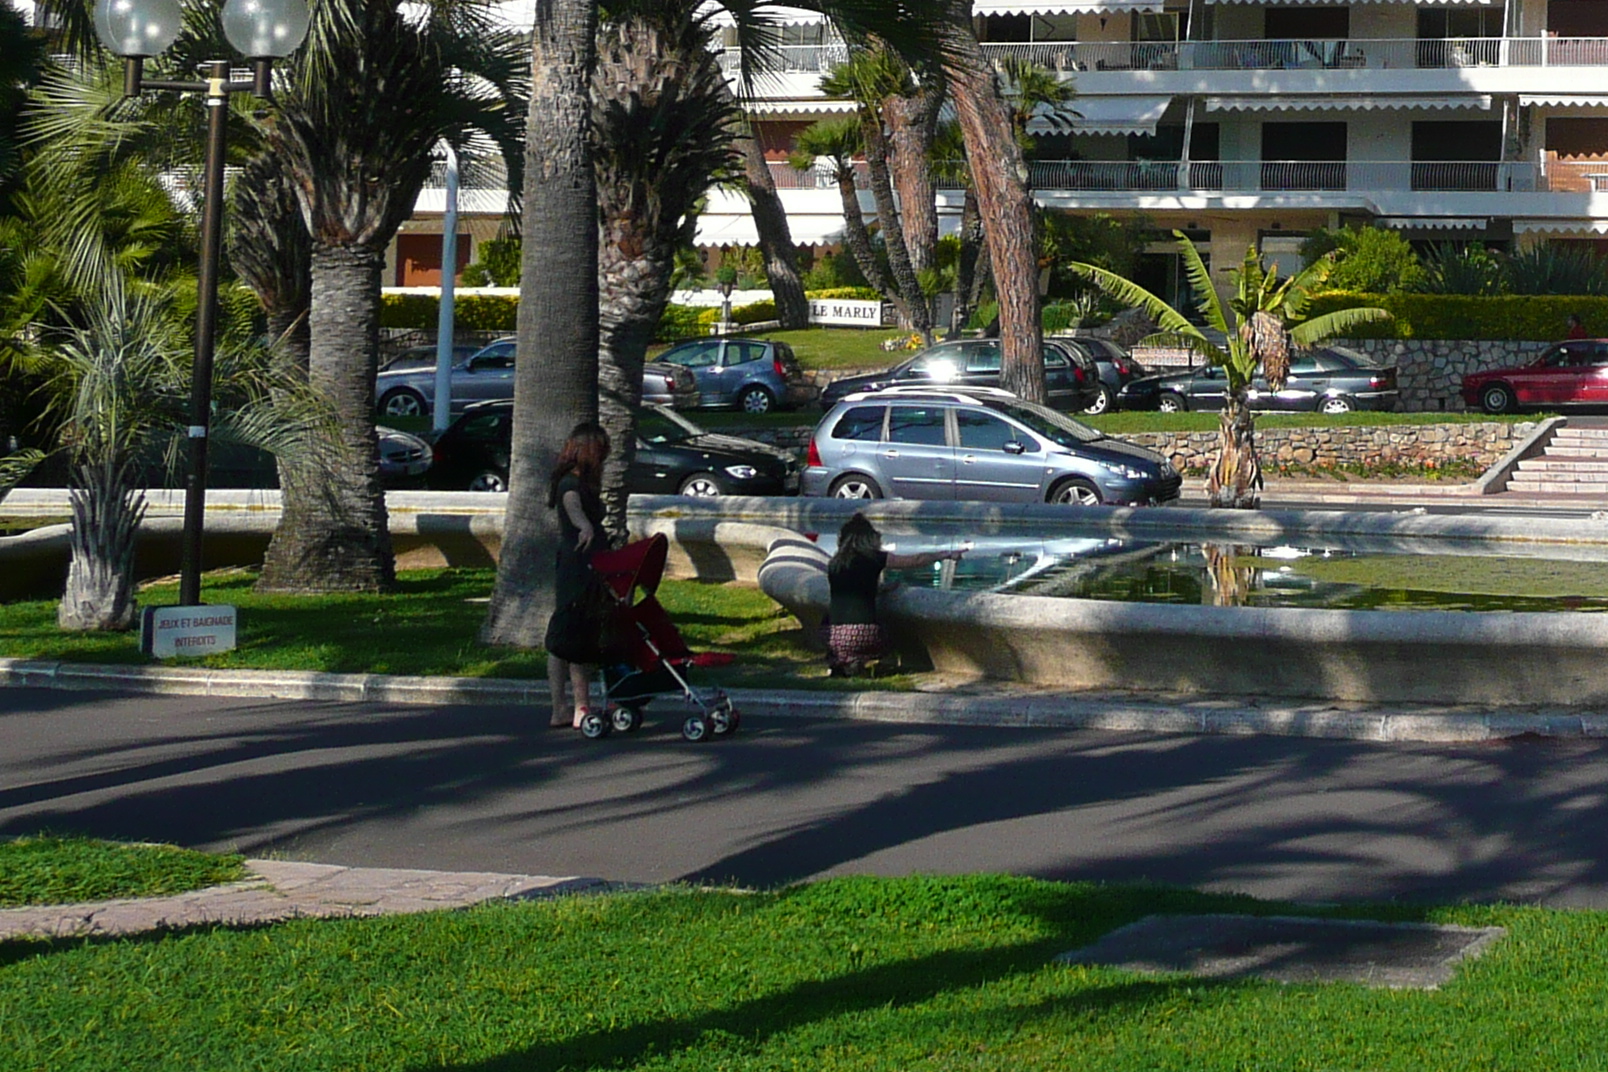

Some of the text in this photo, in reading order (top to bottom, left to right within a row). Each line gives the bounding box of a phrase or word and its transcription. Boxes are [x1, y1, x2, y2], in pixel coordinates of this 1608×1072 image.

[813, 305, 877, 319] LE MARLY
[159, 615, 234, 629] JEUX ET BAIGNADE
[174, 635, 217, 647] INTERDITS
